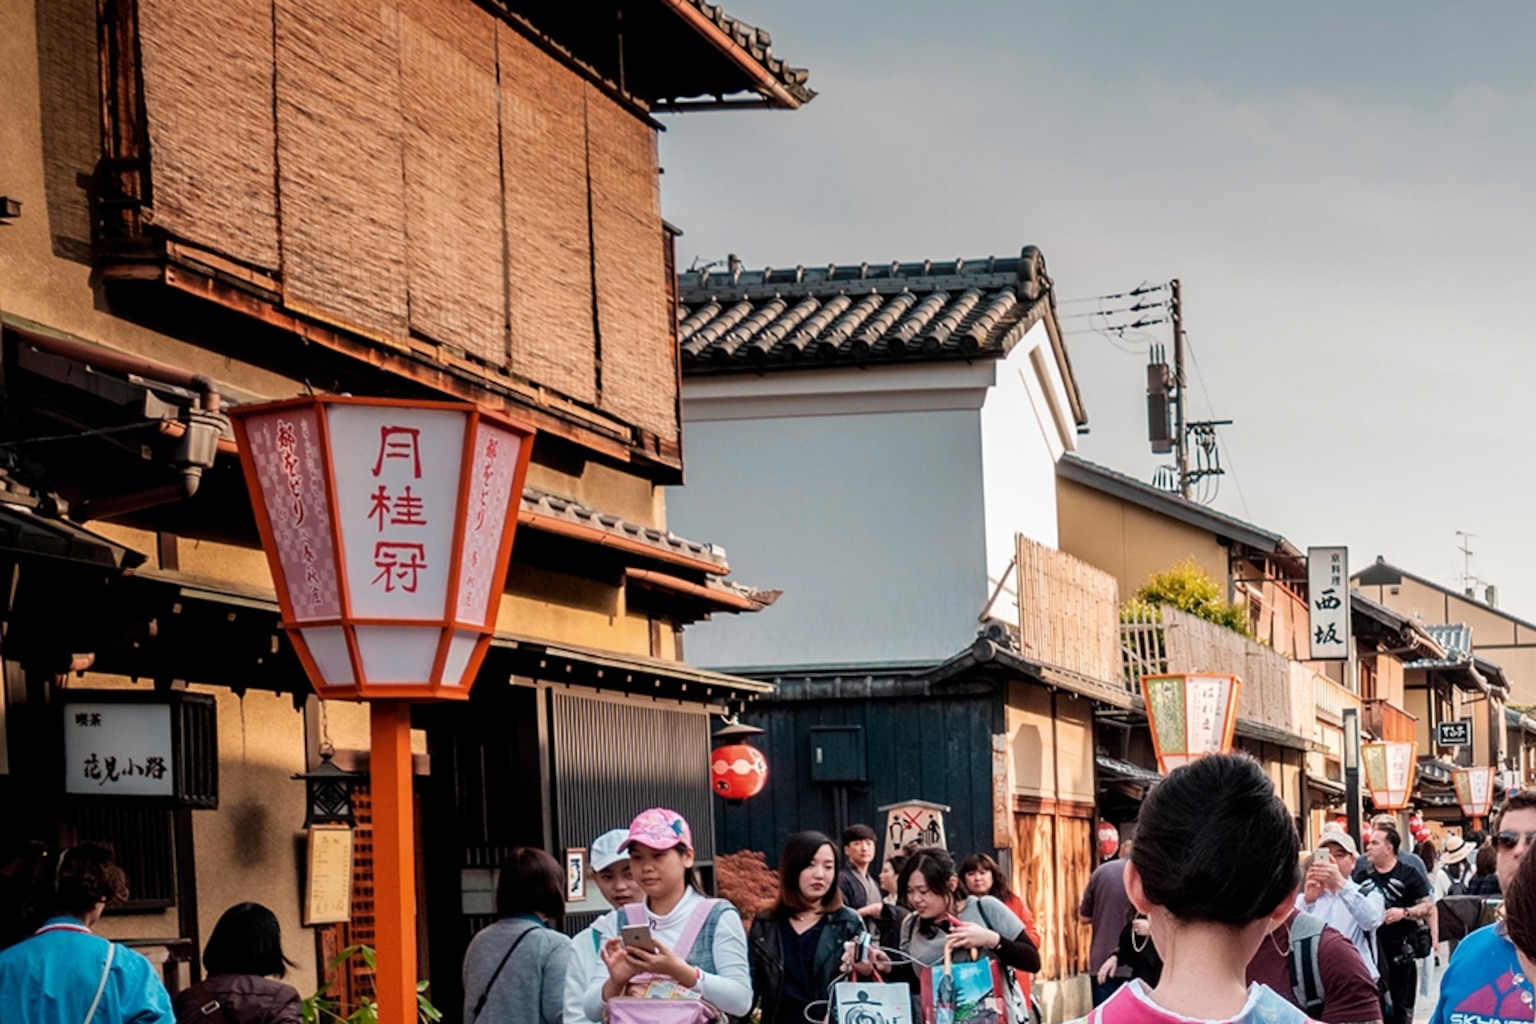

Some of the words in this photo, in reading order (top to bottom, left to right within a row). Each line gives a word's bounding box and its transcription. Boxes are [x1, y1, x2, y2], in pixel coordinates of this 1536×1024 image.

[367, 425, 427, 593] 月桂冠
[75, 713, 101, 727] 喫茶
[84, 753, 167, 786] 花見小路
